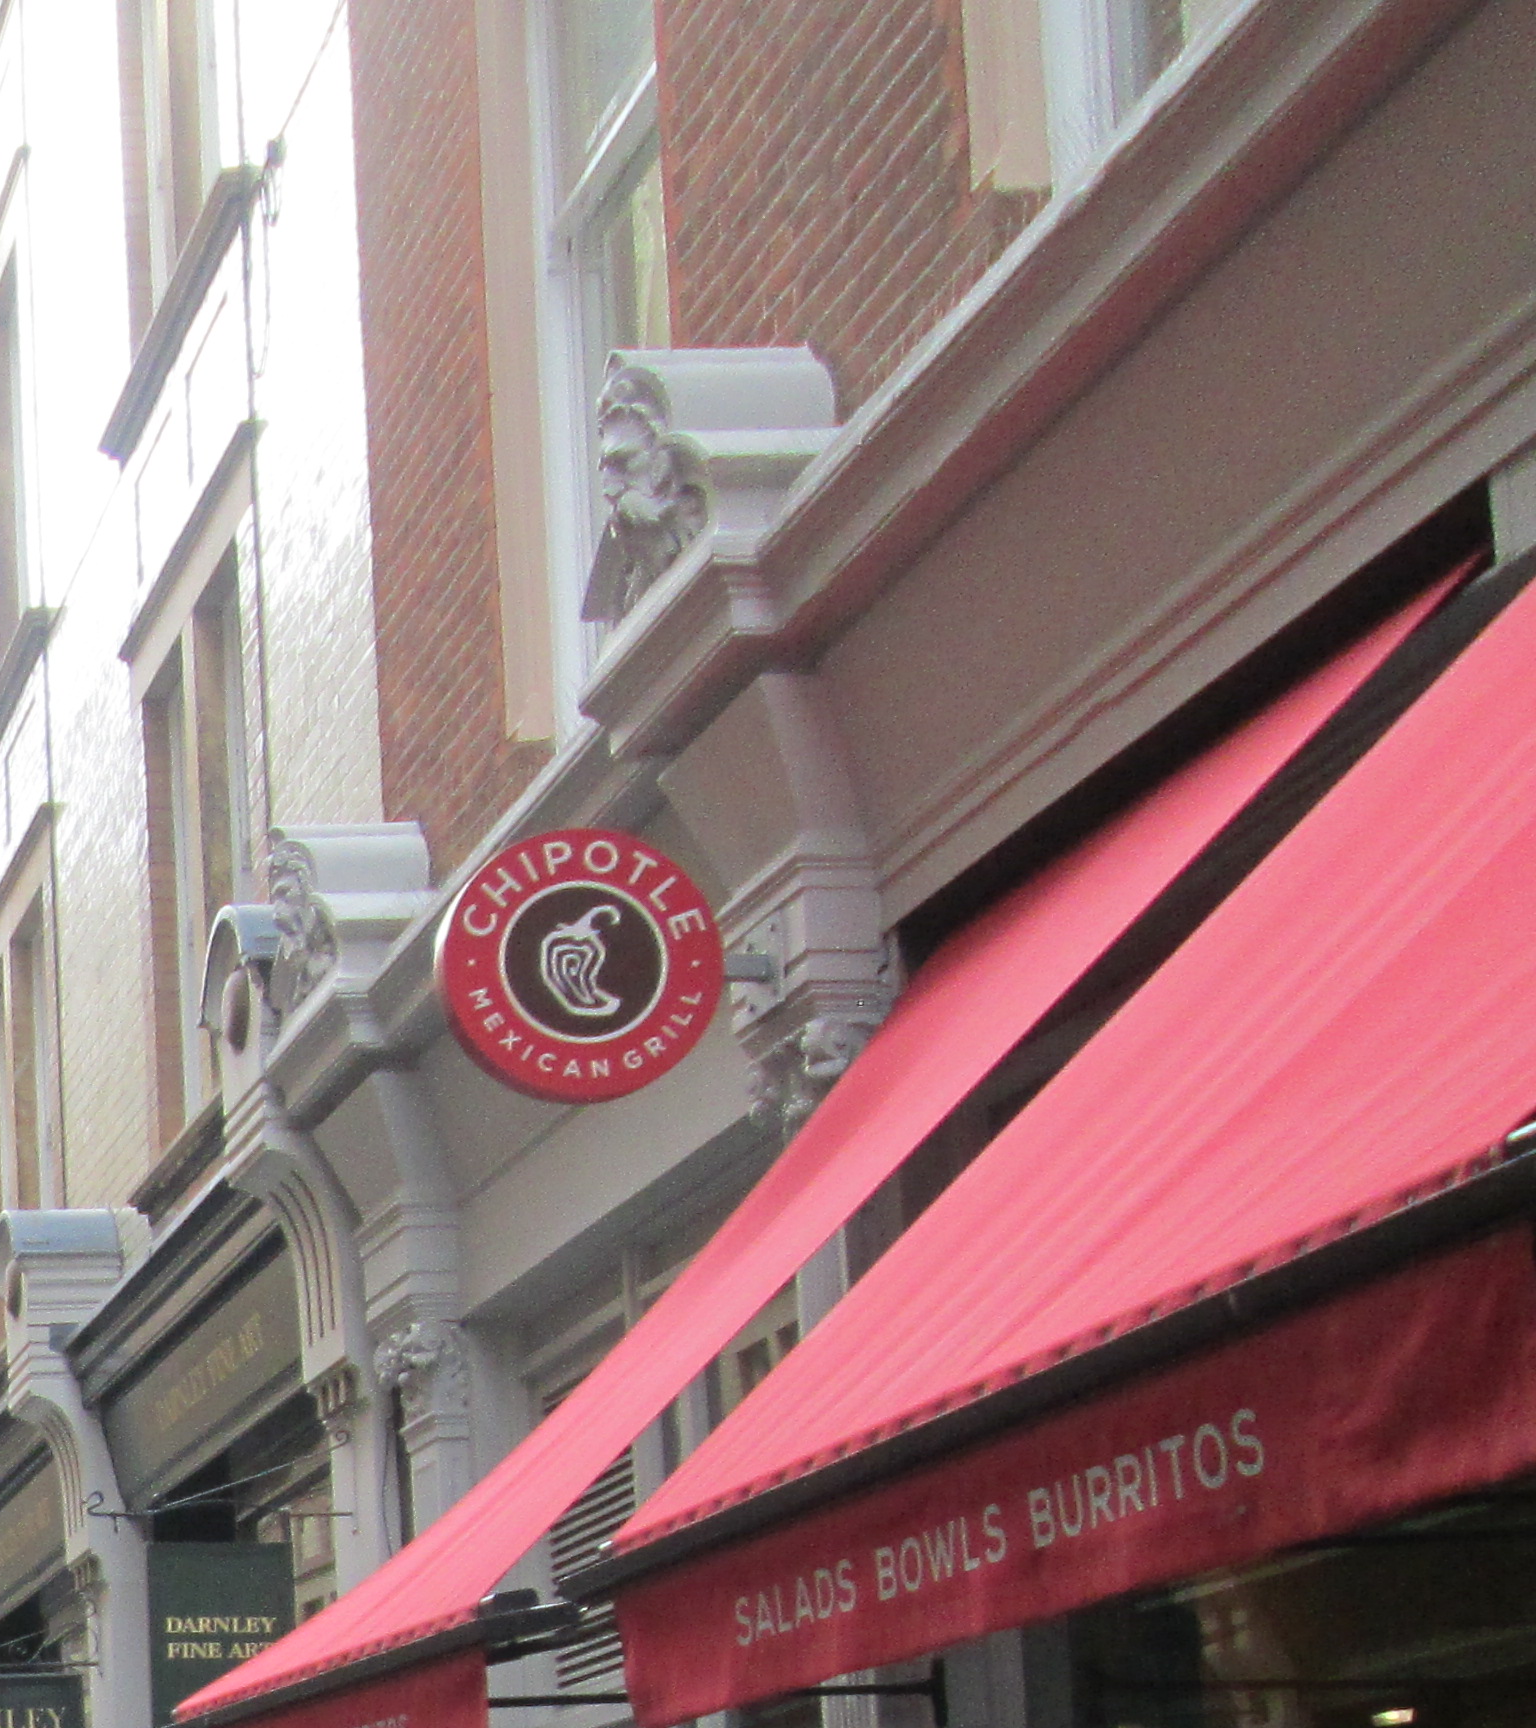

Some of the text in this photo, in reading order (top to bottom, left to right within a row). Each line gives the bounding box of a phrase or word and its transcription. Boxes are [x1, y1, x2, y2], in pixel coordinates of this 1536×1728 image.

[462, 839, 708, 941] CHIPOTLE
[468, 987, 704, 1079] MEXICAN GRILL
[733, 1407, 1266, 1647] SALADS BOWLS BURRITOS
[164, 1616, 278, 1634] DARNLEY
[166, 1641, 222, 1659] FINE
